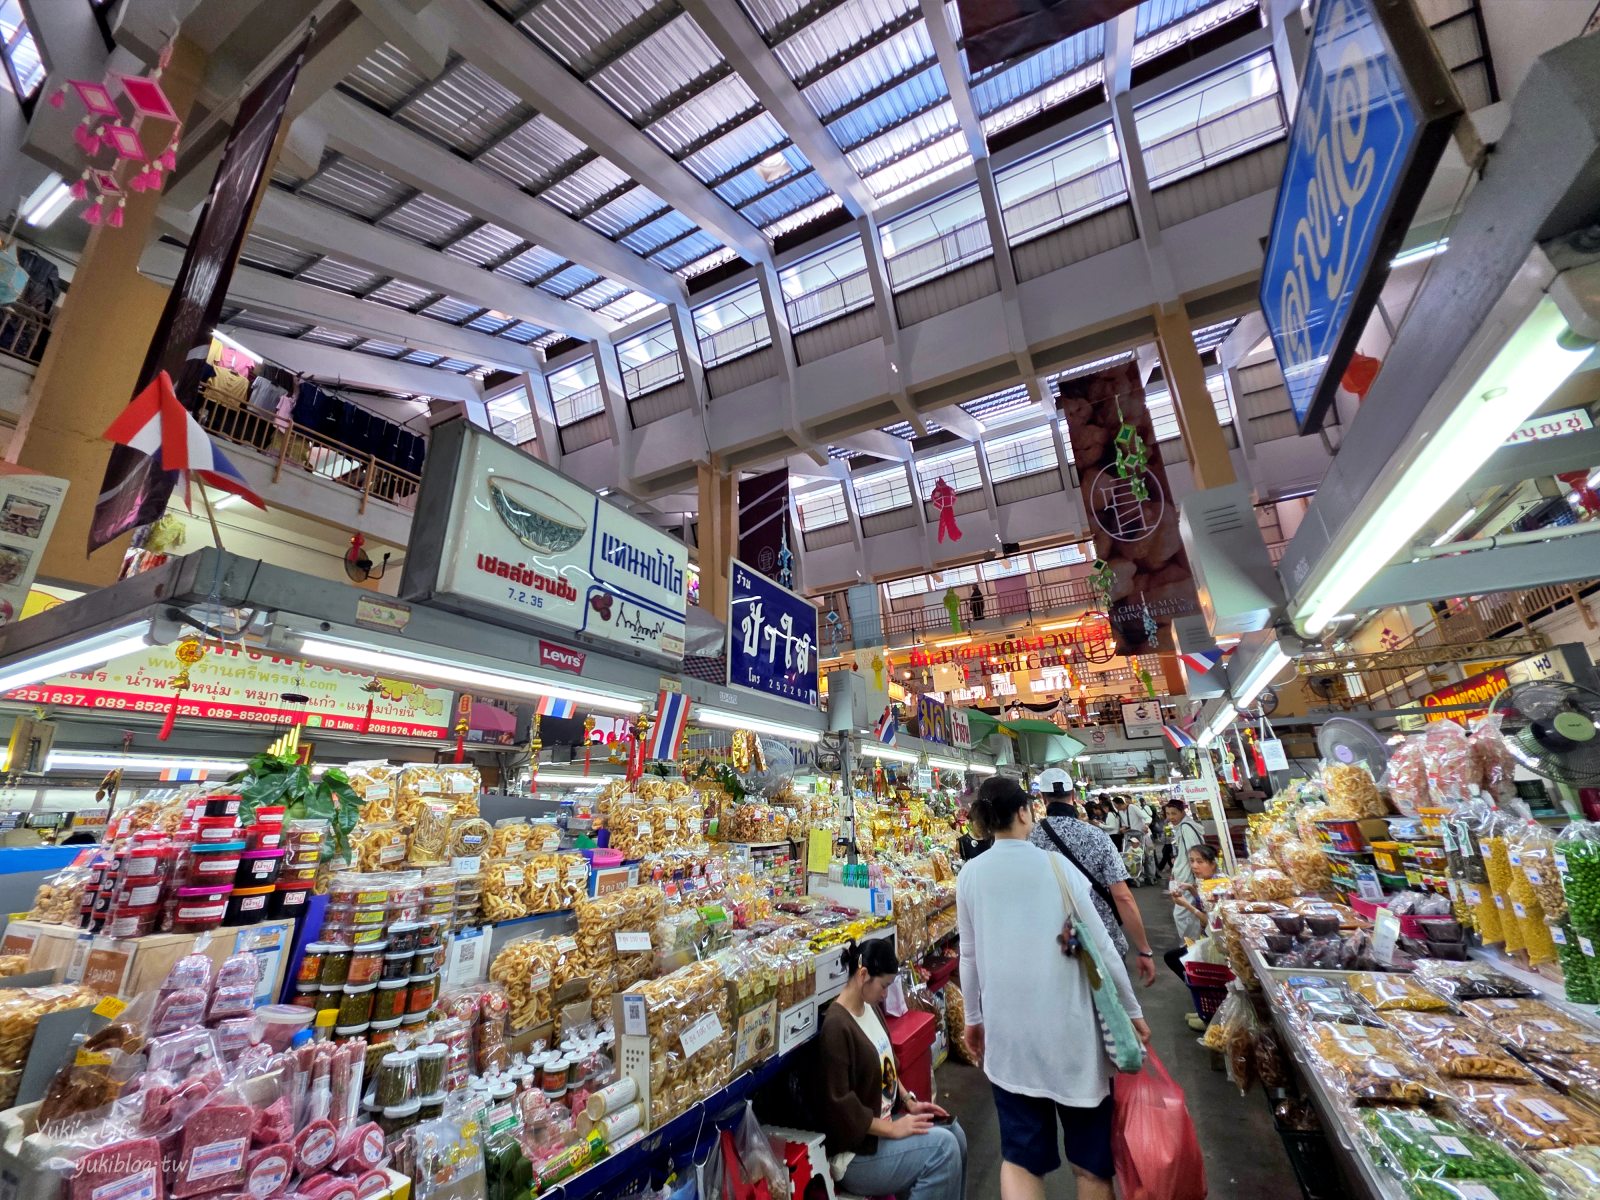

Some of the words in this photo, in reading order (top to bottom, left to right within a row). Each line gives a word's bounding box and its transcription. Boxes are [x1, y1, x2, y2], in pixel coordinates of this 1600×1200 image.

[601, 532, 683, 596] แหนมป้าใส
[476, 552, 577, 602] เชลล์ชวนชิม
[736, 569, 751, 589] ร้าน
[508, 587, 543, 608] 7.2.35
[741, 602, 811, 675] ป้าใส
[980, 656, 1021, 676] Food
[325, 718, 335, 728] ID
[337, 719, 354, 731] Line
